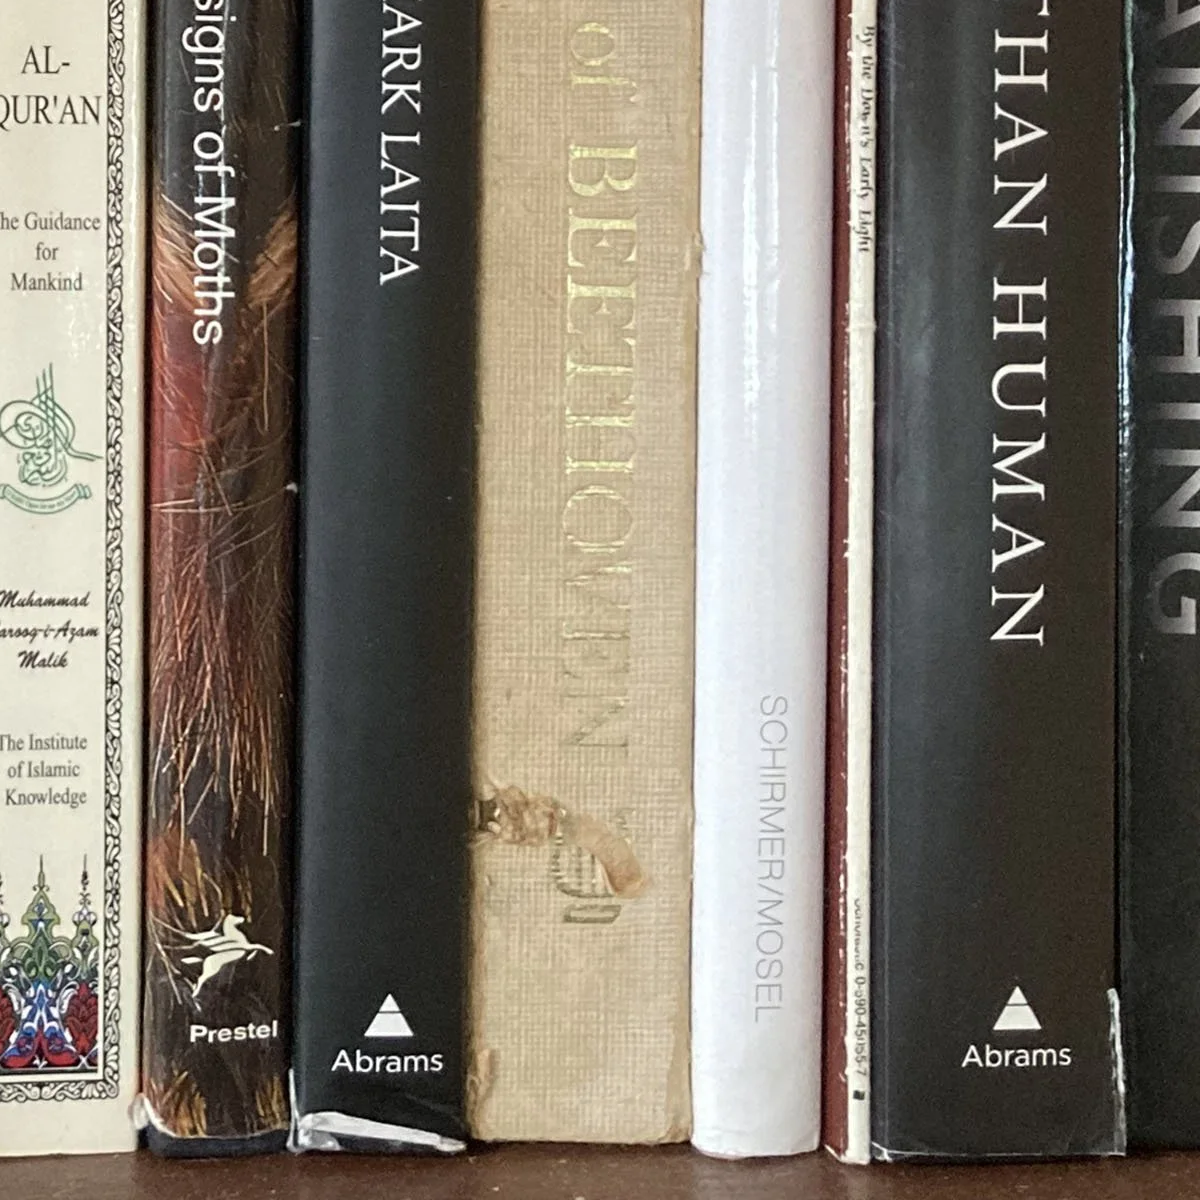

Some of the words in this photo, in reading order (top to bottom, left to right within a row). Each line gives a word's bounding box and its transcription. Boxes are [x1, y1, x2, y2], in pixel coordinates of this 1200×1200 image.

[856, 26, 874, 48] By
[20, 45, 71, 75] AL-
[570, 22, 638, 102] of
[861, 54, 873, 78] the
[860, 88, 873, 148] Dawn's
[193, 129, 235, 177] of
[858, 157, 872, 199] Early
[24, 211, 101, 231] Guidance
[379, 132, 420, 286] LAITA
[853, 209, 872, 251] Light
[35, 242, 59, 261] for
[10, 272, 83, 292] Mankind
[192, 197, 236, 345] Moths
[562, 145, 638, 760] BEETHOVEN
[990, 277, 1047, 646] HUMAN
[17, 650, 69, 669] Malik
[28, 733, 88, 750] Institute
[7, 760, 25, 778] of
[27, 759, 80, 778] Islamic
[5, 788, 88, 810] Knowledge
[755, 695, 788, 1023] SCHIRMER/MOSEL
[190, 1020, 278, 1043] Prestel
[331, 1049, 443, 1073] Abrams
[962, 1044, 1072, 1068] Abrams
